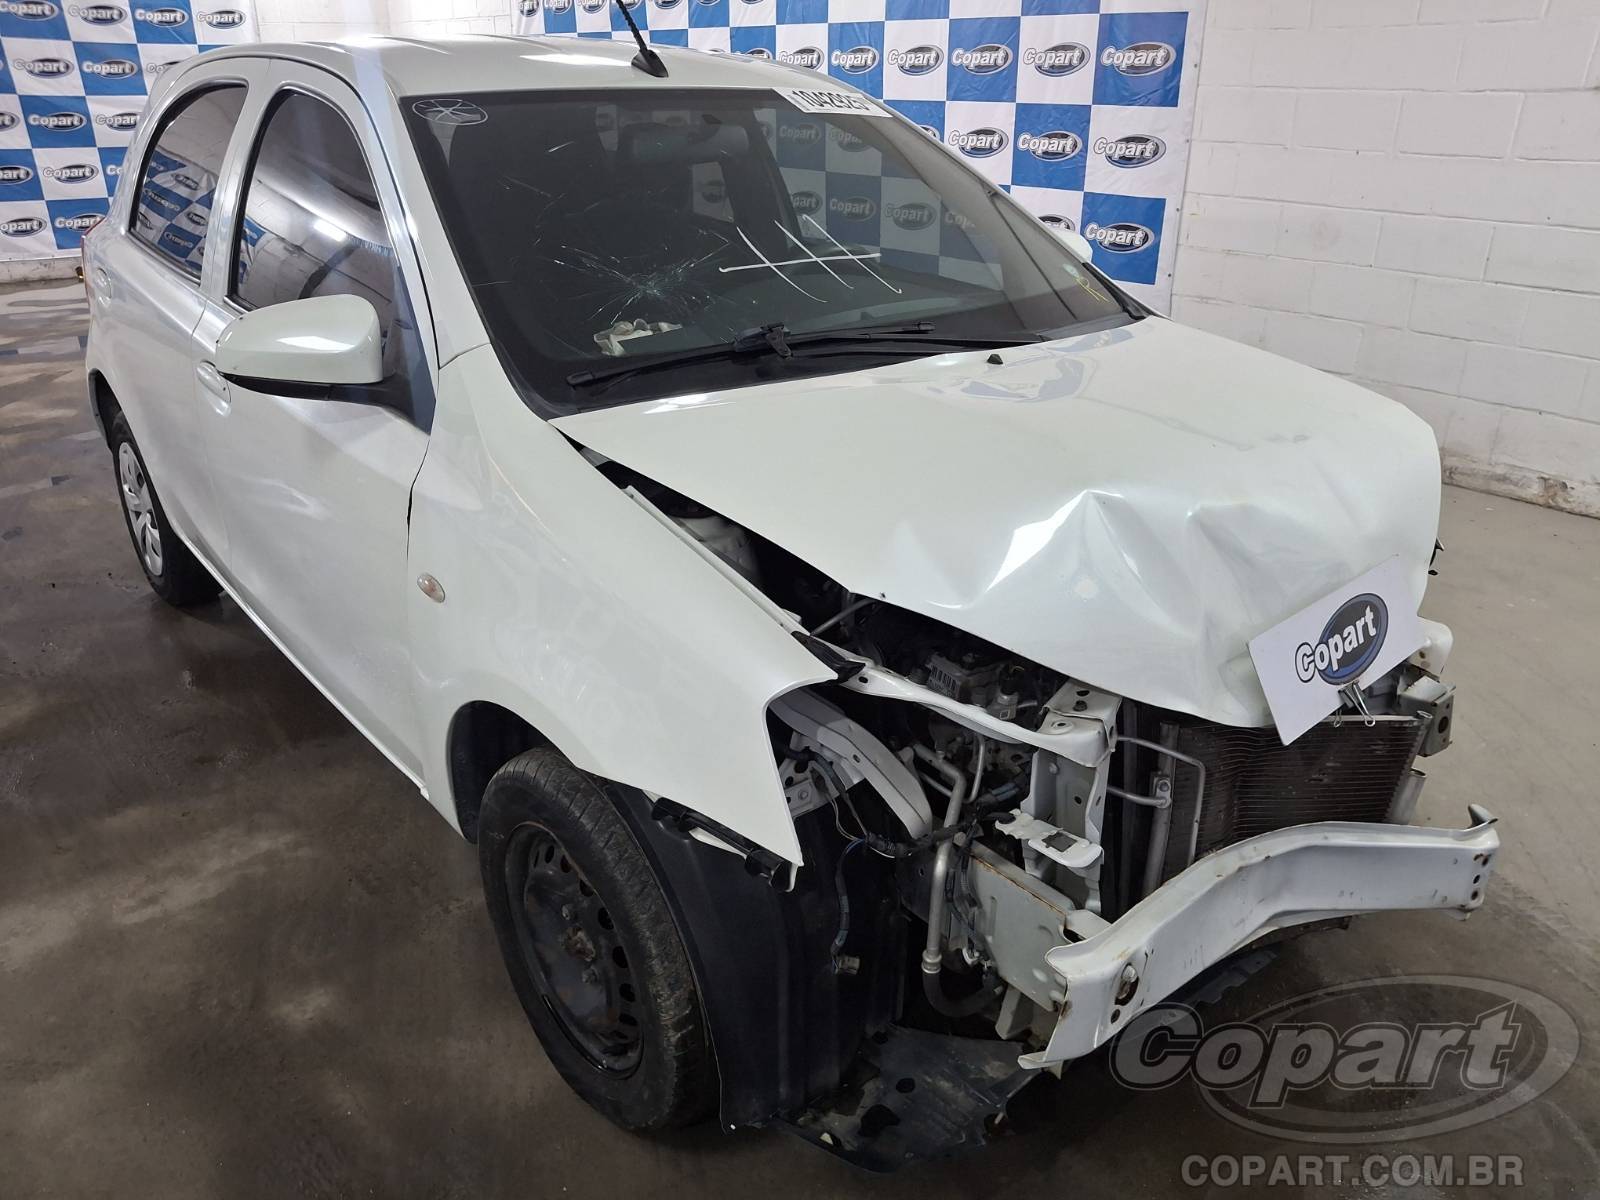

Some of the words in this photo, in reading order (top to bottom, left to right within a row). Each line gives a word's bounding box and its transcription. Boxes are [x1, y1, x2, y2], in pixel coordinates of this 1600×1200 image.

[68, 4, 122, 20] Copart
[135, 8, 183, 24] Copart
[198, 11, 240, 24] Copart
[14, 58, 66, 73] Copart
[831, 49, 874, 70] Copart
[888, 49, 937, 70] Copart
[952, 47, 1006, 70] Copart
[1023, 47, 1083, 69] Copart
[1101, 46, 1167, 70] Copart
[82, 60, 132, 75] Copart
[28, 112, 81, 129] Copart
[95, 114, 141, 128] Copar
[780, 124, 816, 142] Copart
[949, 130, 1001, 149] Copart
[1017, 132, 1074, 156] Copart
[1094, 137, 1156, 161] Copart
[43, 166, 93, 181] Copart
[829, 198, 871, 216] Copart
[885, 203, 930, 223] Copart
[0, 216, 41, 233] opart
[1084, 222, 1144, 246] Copart
[1295, 604, 1377, 684] Copart
